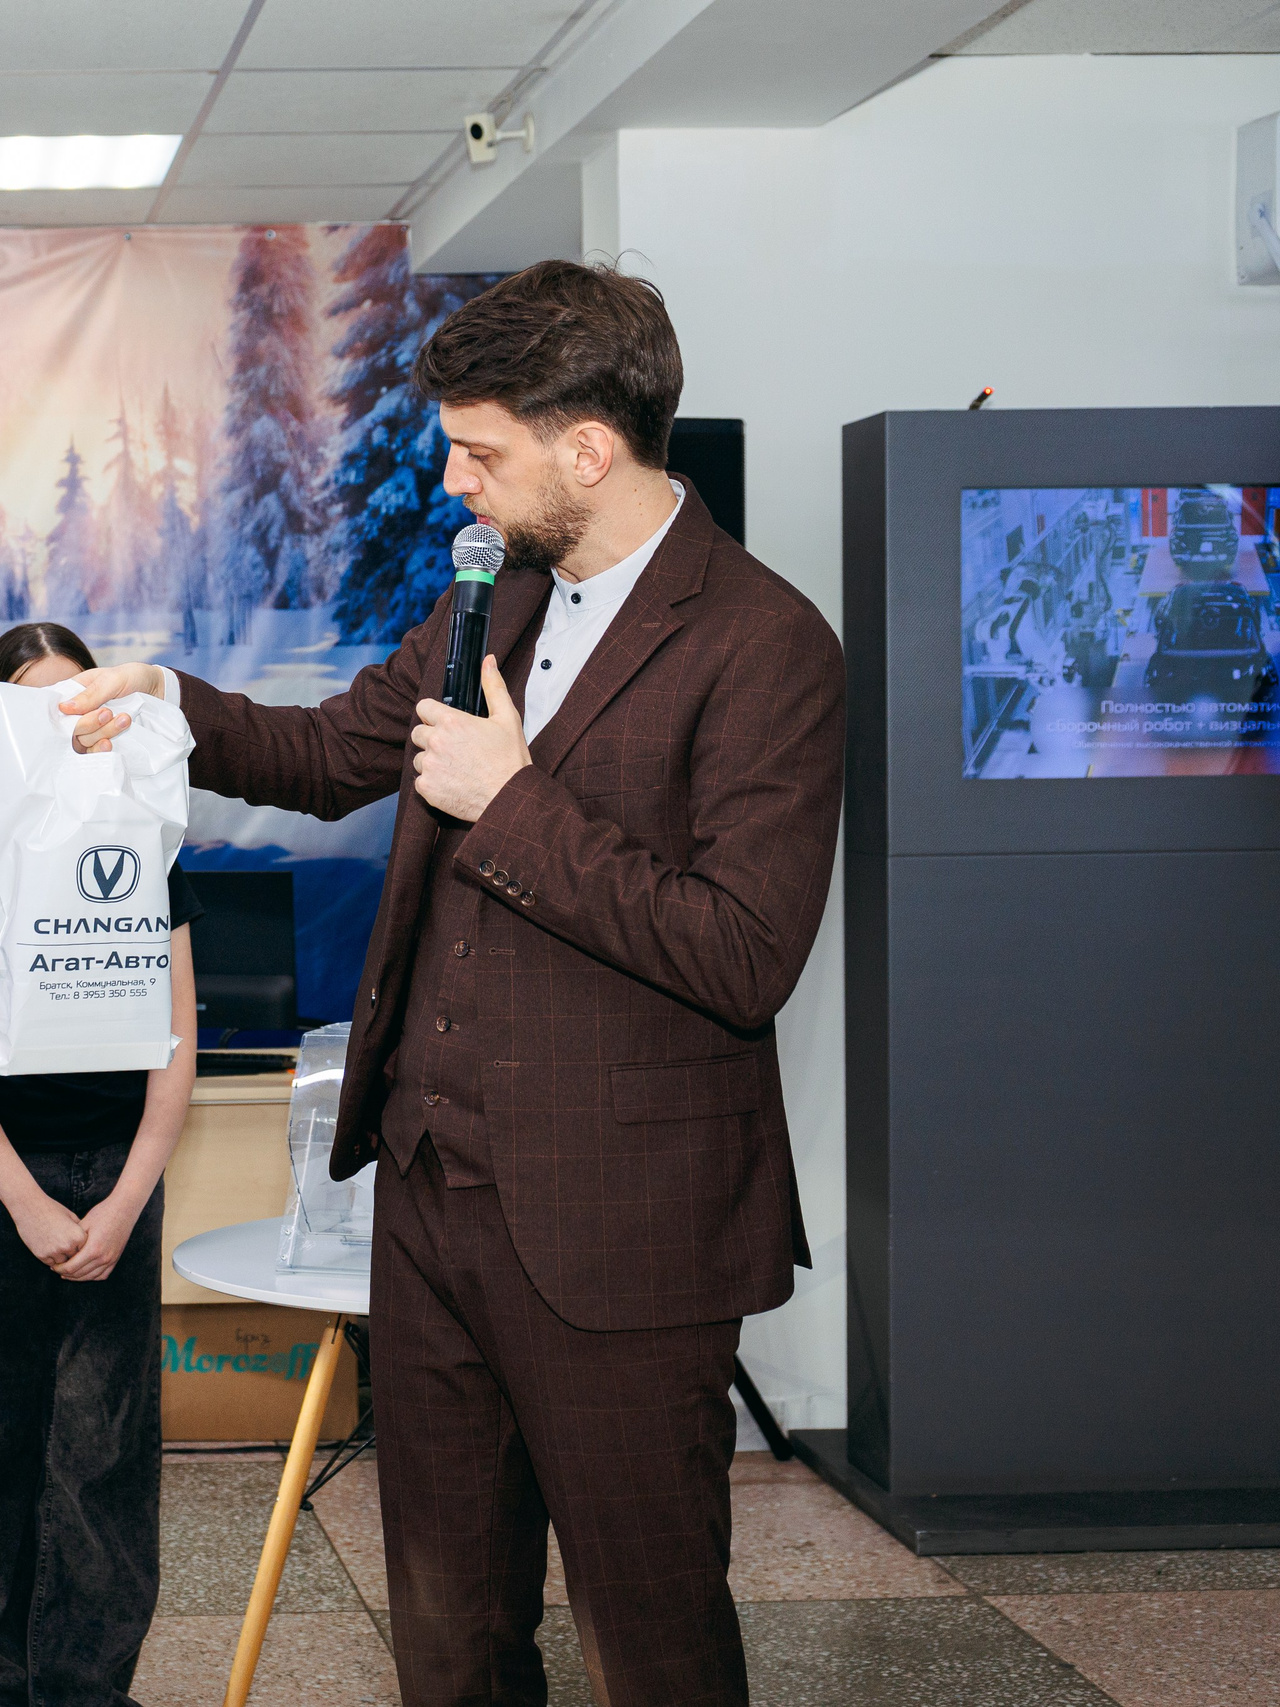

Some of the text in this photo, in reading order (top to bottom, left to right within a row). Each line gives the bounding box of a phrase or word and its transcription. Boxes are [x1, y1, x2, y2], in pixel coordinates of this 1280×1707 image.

[1100, 699, 1196, 714] Полностью
[1047, 717, 1140, 734] сборочный
[1142, 717, 1193, 736] робот
[34, 915, 169, 934] CHANGAN
[29, 951, 169, 972] Агат-Авто
[39, 977, 157, 991] Братск, Коммунальная, 9
[73, 991, 80, 1000] 8
[82, 990, 106, 1000] 3953
[108, 989, 127, 998] 350
[129, 988, 148, 997] 555
